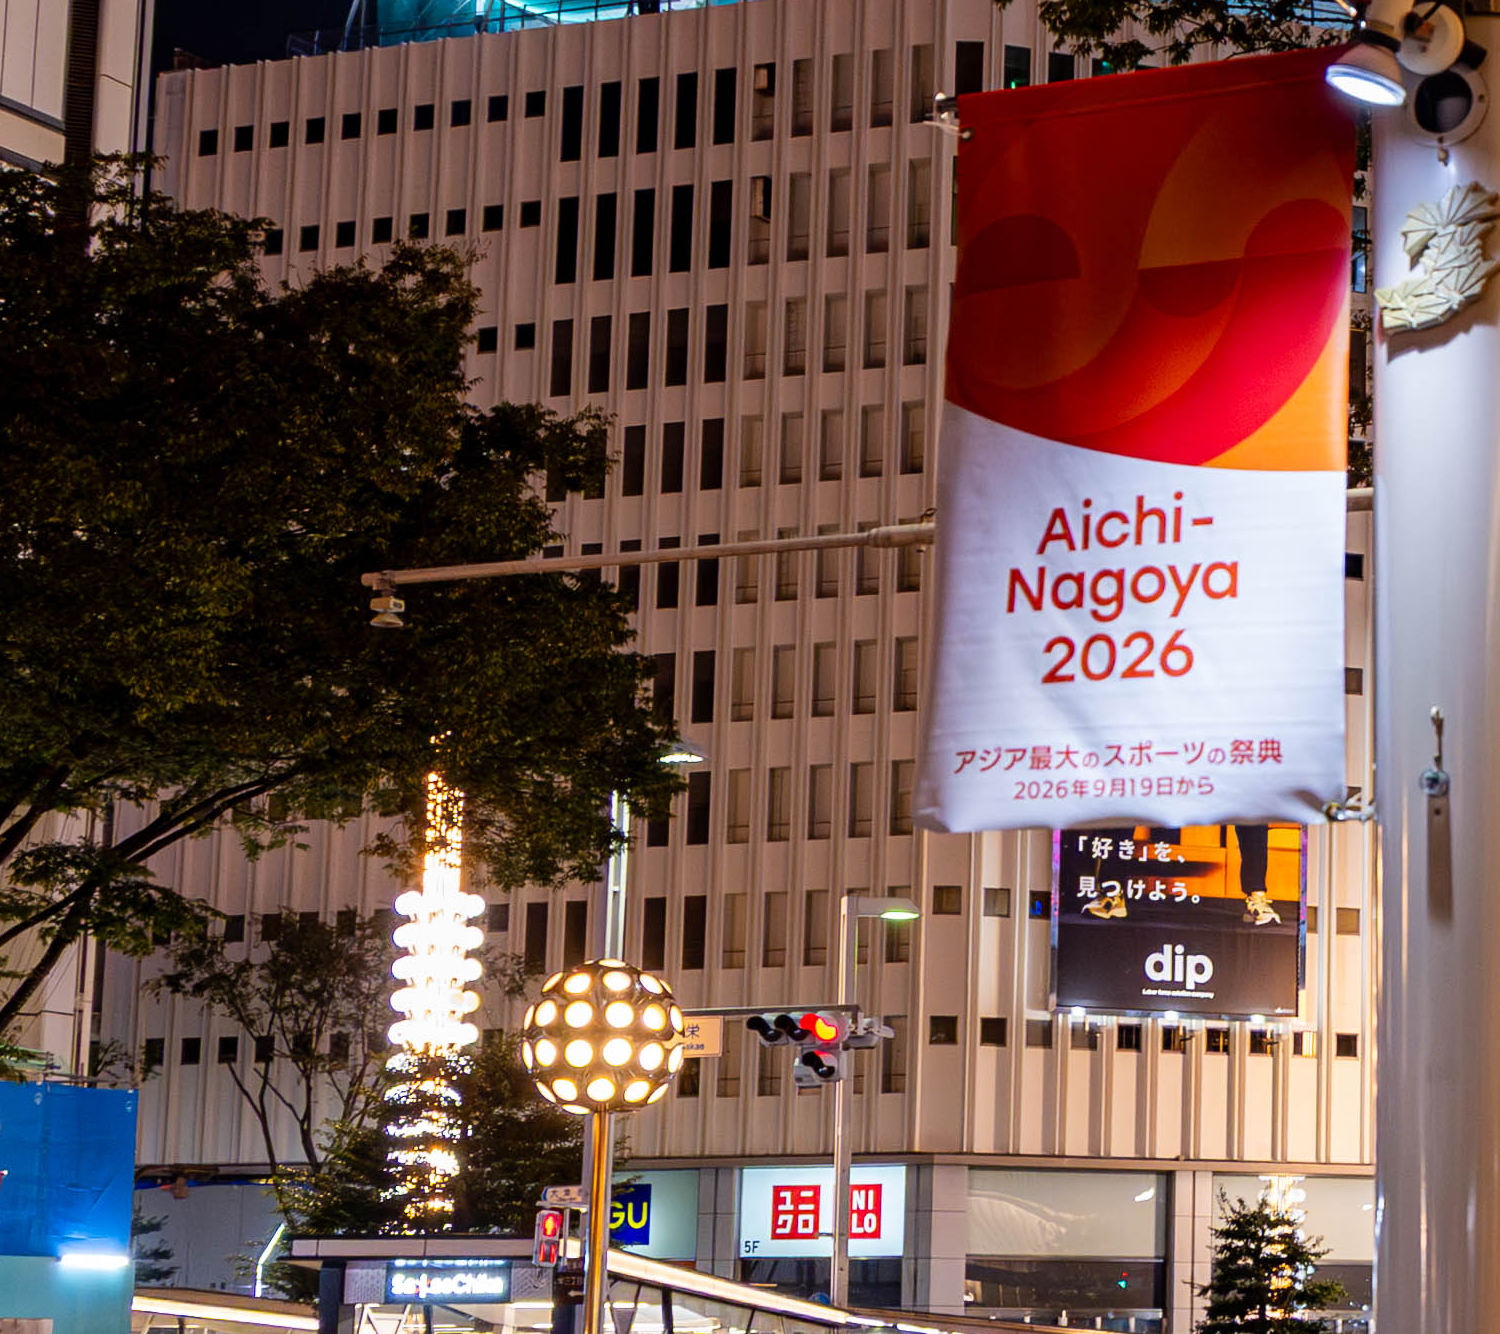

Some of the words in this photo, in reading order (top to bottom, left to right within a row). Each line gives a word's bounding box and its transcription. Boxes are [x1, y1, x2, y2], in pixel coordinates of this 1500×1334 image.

[1036, 490, 1214, 555] Aichi-
[1006, 560, 1239, 623] Nagoya
[1041, 628, 1194, 684] 2026
[953, 737, 1284, 774] アジア最大のスポーツの祭典
[1012, 776, 1215, 800] 2026年9月19日から
[1076, 875, 1200, 904] 見つけよう。
[1144, 943, 1214, 990] dip
[685, 1022, 700, 1038] 栄
[850, 1189, 874, 1211] NI
[850, 1213, 877, 1234] LO
[744, 1240, 760, 1253] 5F
